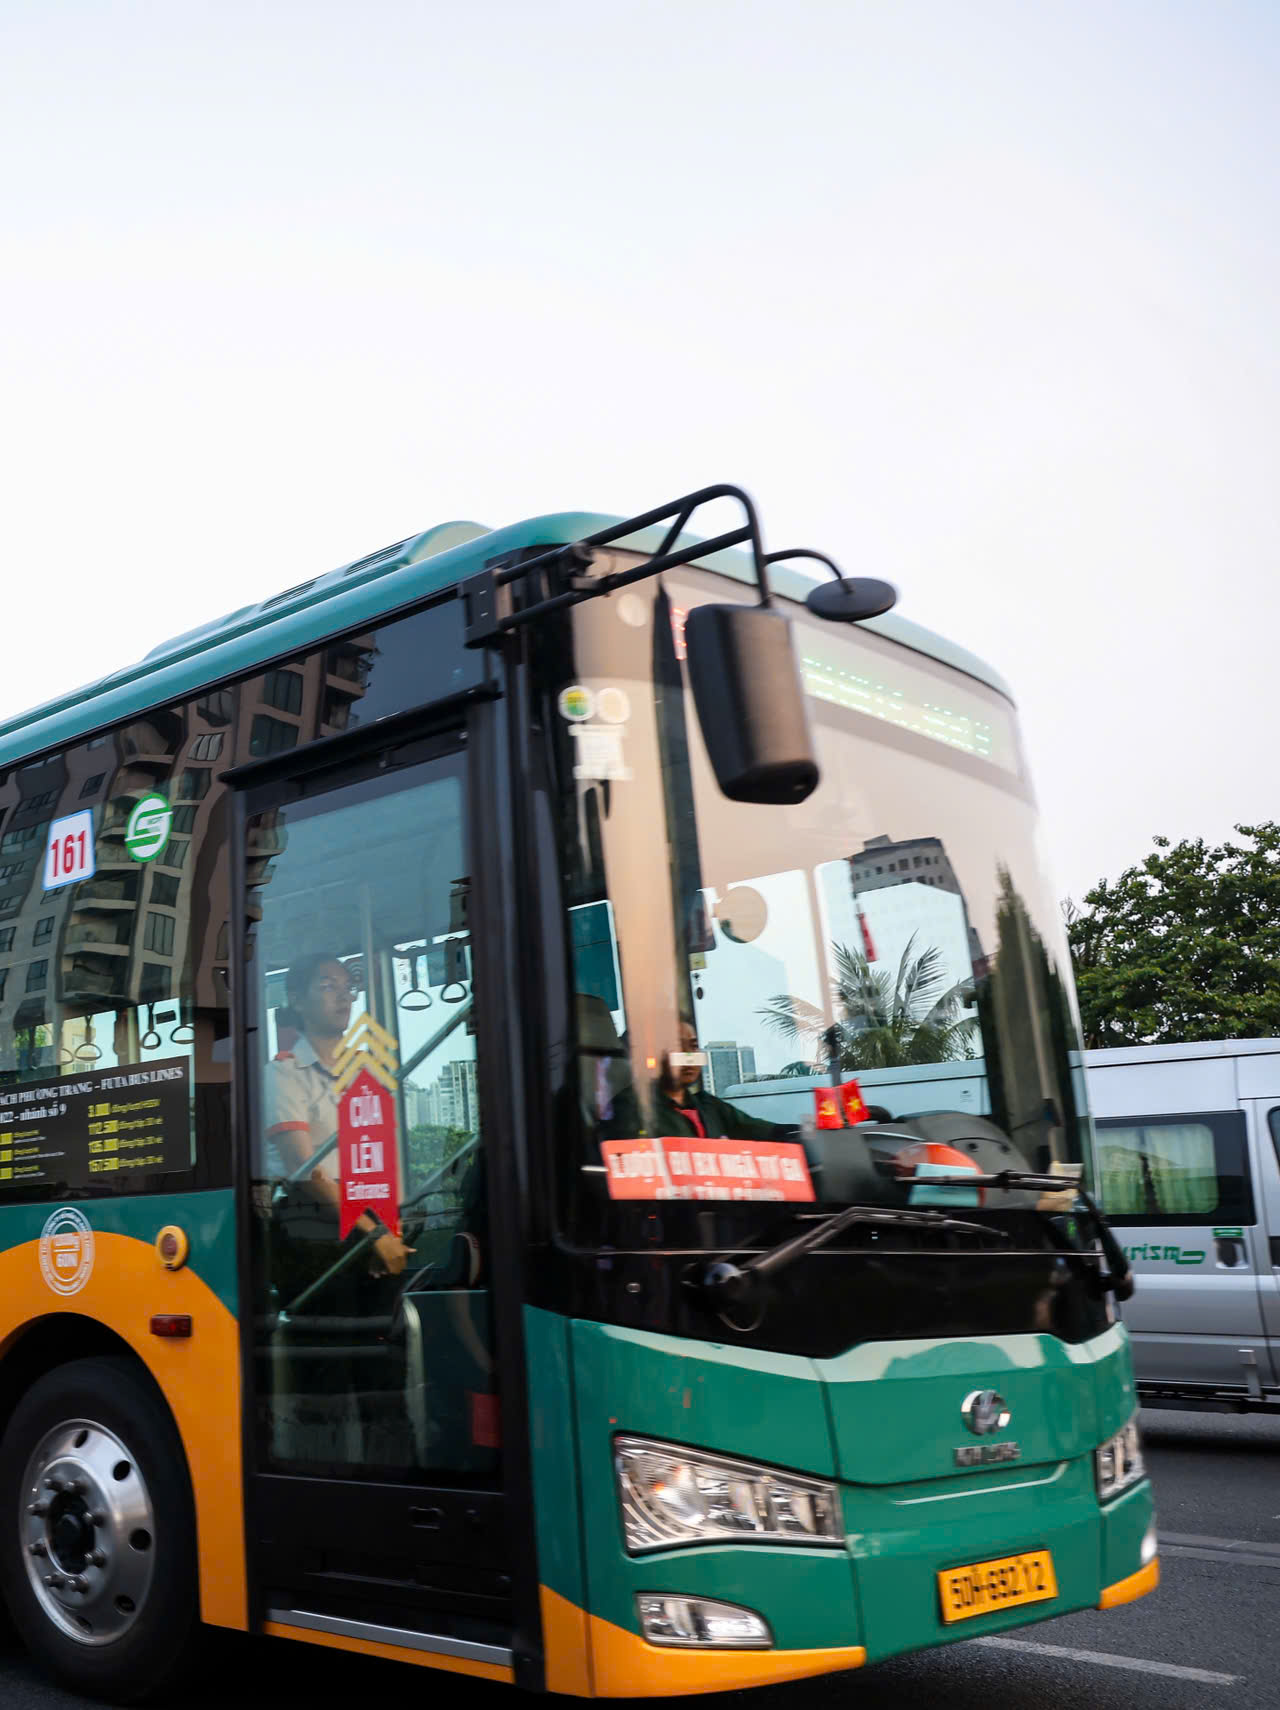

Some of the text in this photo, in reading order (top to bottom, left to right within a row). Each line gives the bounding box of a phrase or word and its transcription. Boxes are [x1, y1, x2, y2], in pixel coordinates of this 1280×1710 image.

[51, 830, 86, 877] 161
[349, 1085, 384, 1128] CỬA
[350, 1135, 384, 1174] LÊN
[346, 1181, 390, 1200] Entrance
